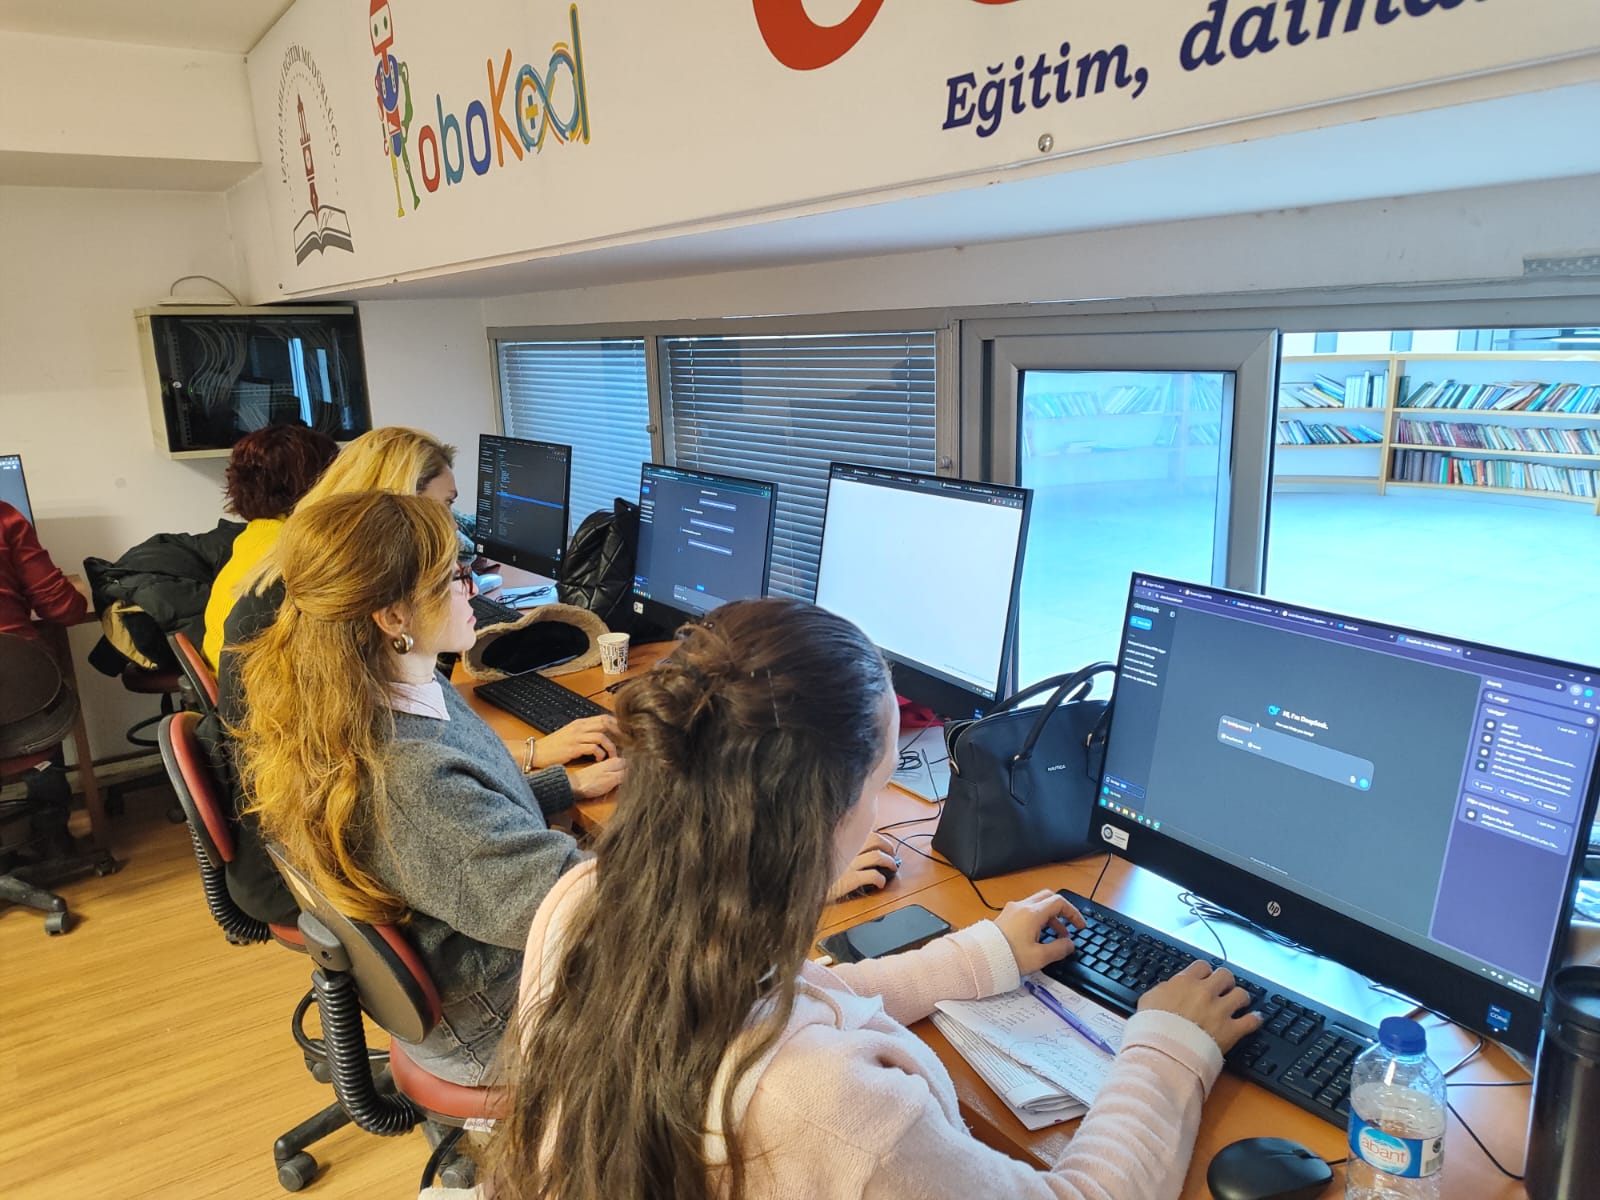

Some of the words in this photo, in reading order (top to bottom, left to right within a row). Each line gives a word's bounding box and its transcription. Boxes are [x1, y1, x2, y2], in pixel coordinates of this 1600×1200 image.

[942, 42, 1148, 137] Eğitim,
[1179, 0, 1464, 71] daim
[1268, 901, 1281, 916] hp
[1361, 1136, 1407, 1164] abant
